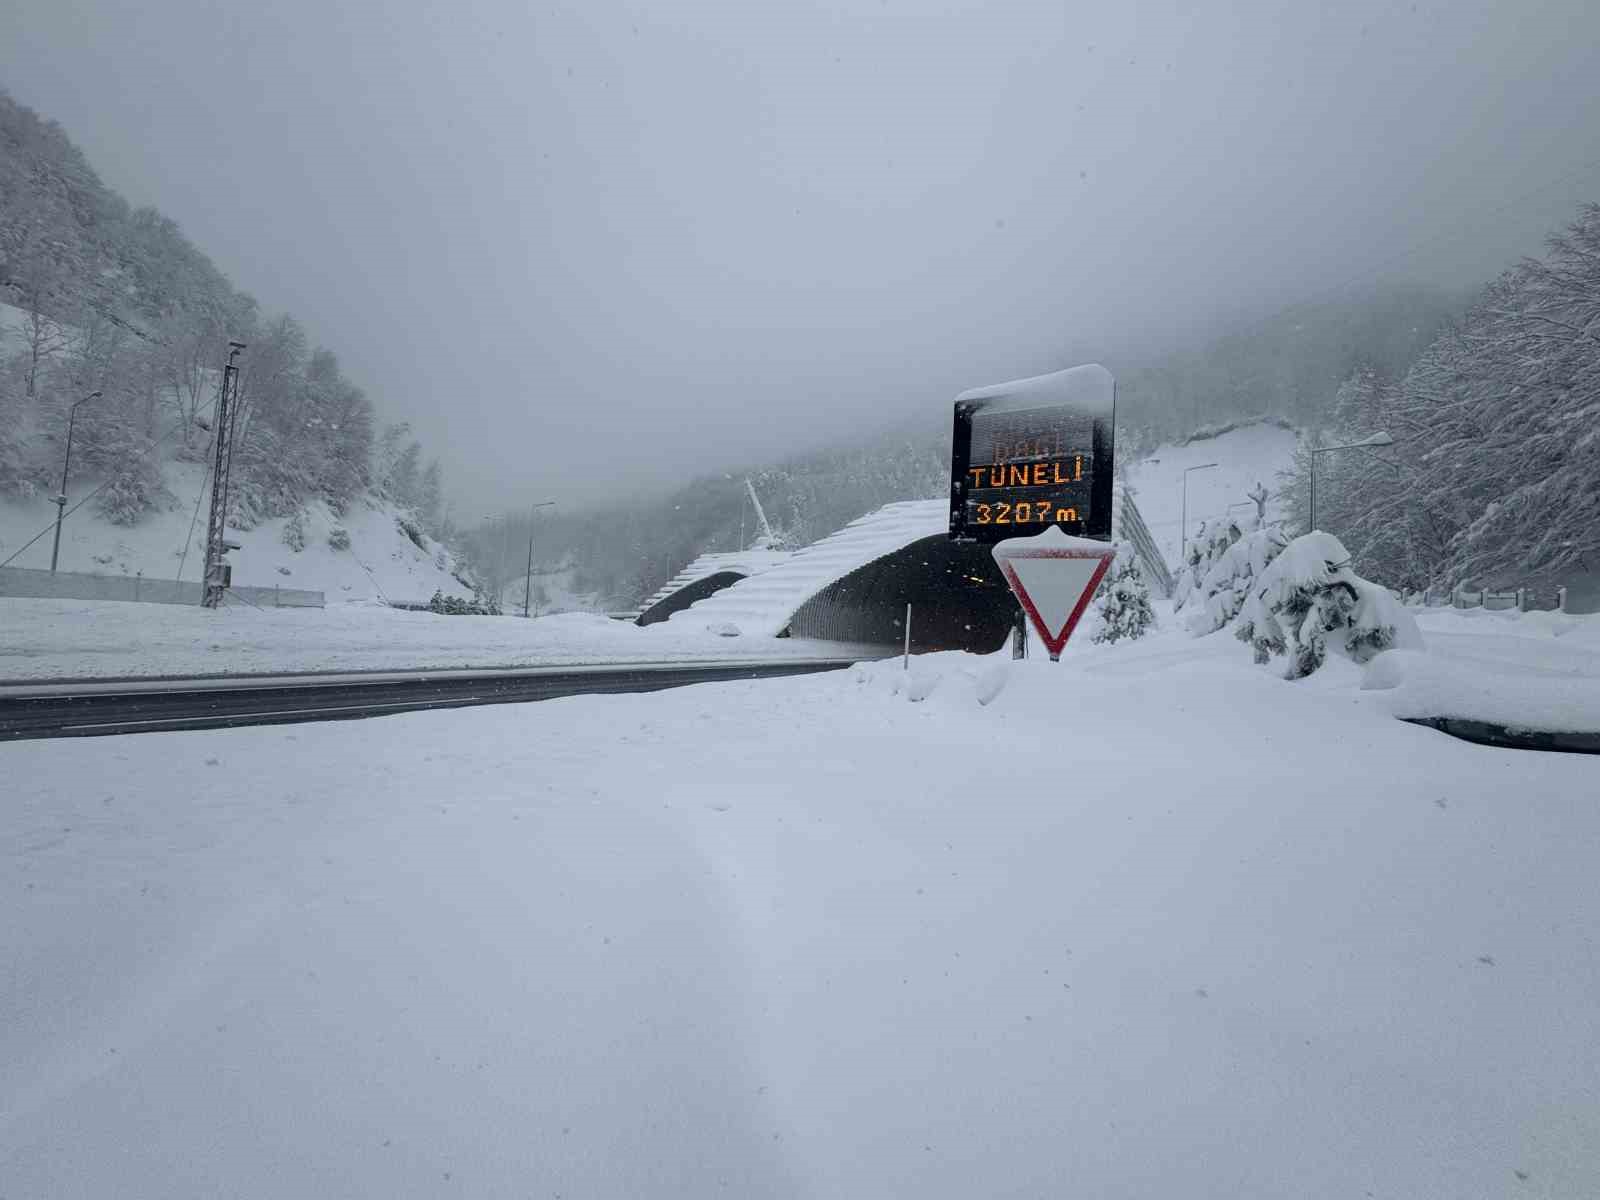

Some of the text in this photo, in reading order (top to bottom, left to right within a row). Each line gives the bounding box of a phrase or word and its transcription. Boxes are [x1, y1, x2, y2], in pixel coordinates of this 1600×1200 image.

[969, 455, 1082, 487] TÜNELİ
[977, 502, 1076, 525] 3207 m
